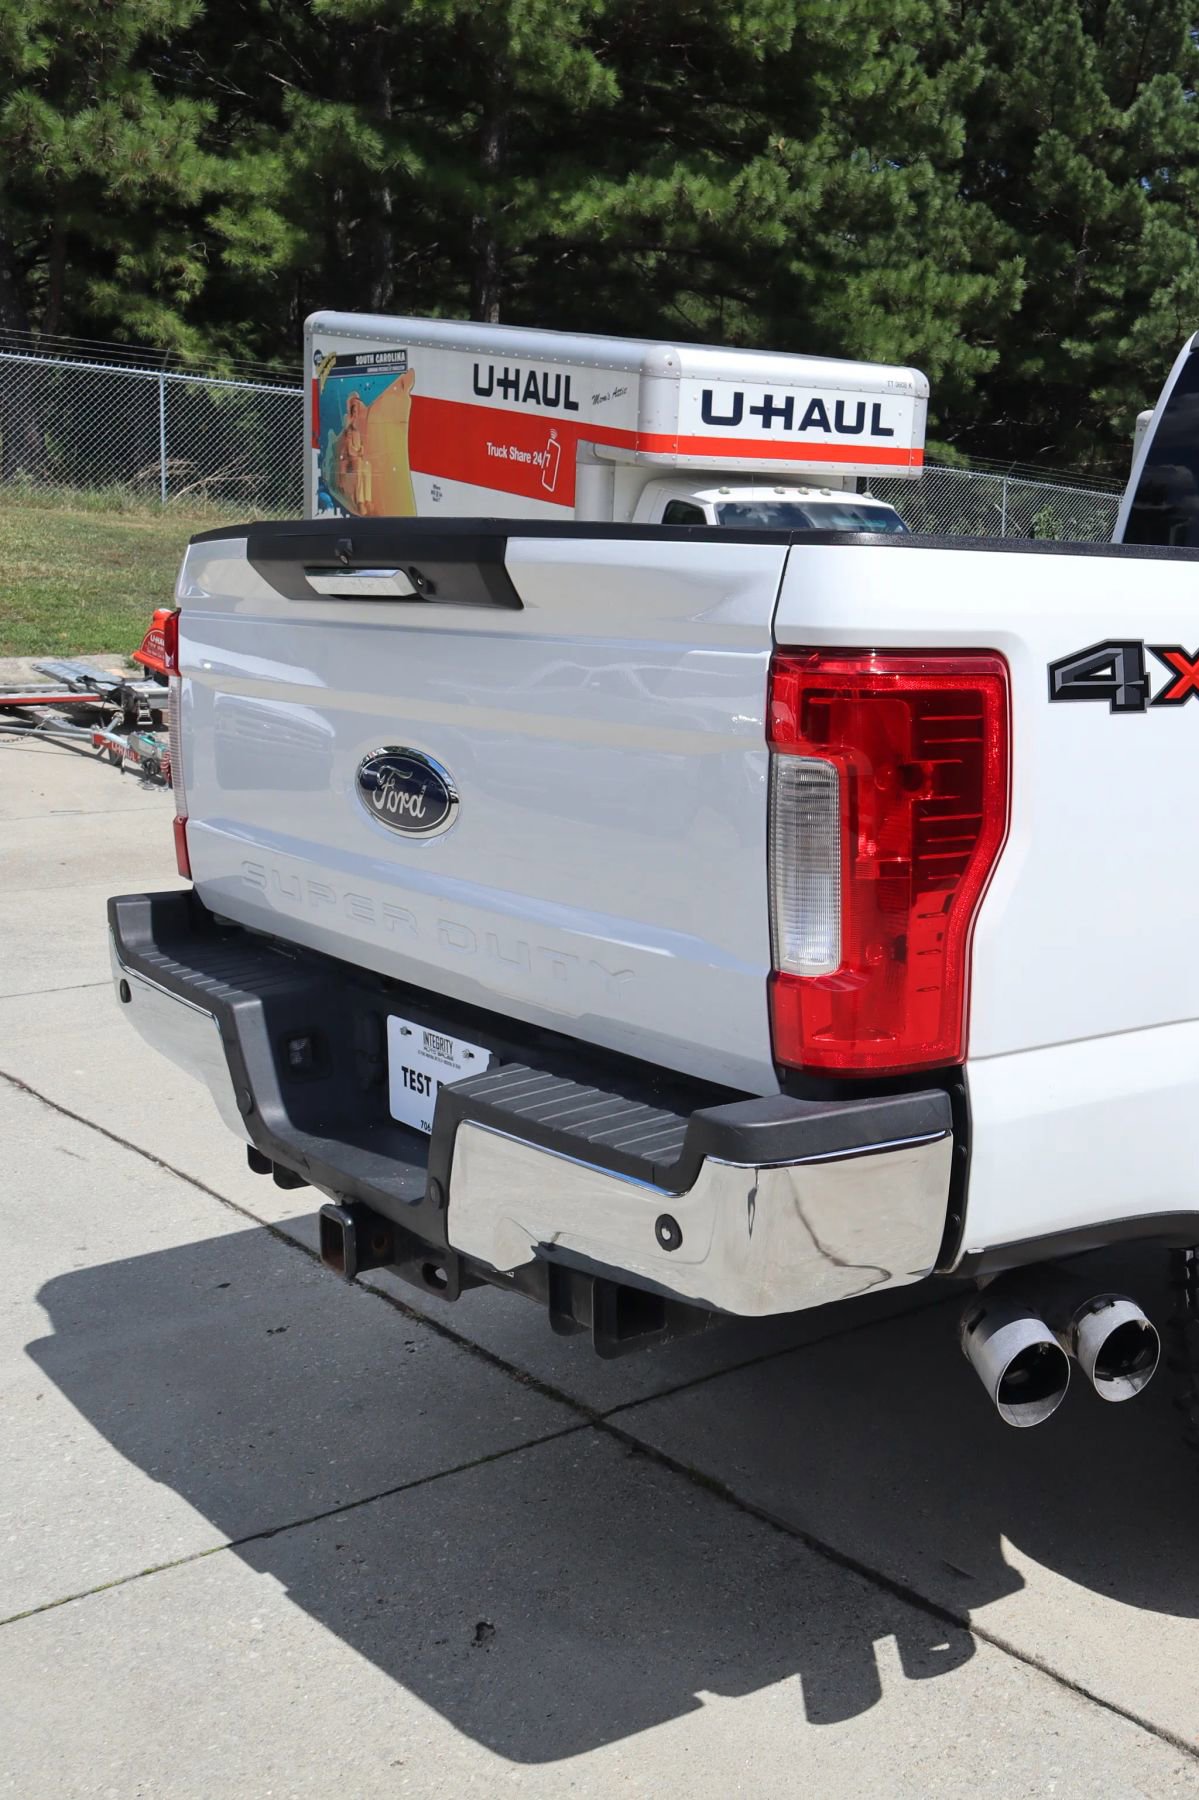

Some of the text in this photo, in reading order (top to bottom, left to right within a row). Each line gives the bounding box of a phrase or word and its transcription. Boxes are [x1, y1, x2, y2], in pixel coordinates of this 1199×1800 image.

[355, 351, 406, 365] SOUTH CAROLINA
[473, 363, 579, 411] U-HAUL
[701, 389, 895, 437] U-HAUL
[486, 441, 551, 469] Truck Share 24/7
[372, 765, 428, 819] Ford
[239, 858, 637, 1001] SUPER DUTY
[422, 1030, 454, 1056] INTEGRITY
[401, 1065, 432, 1097] TEST
